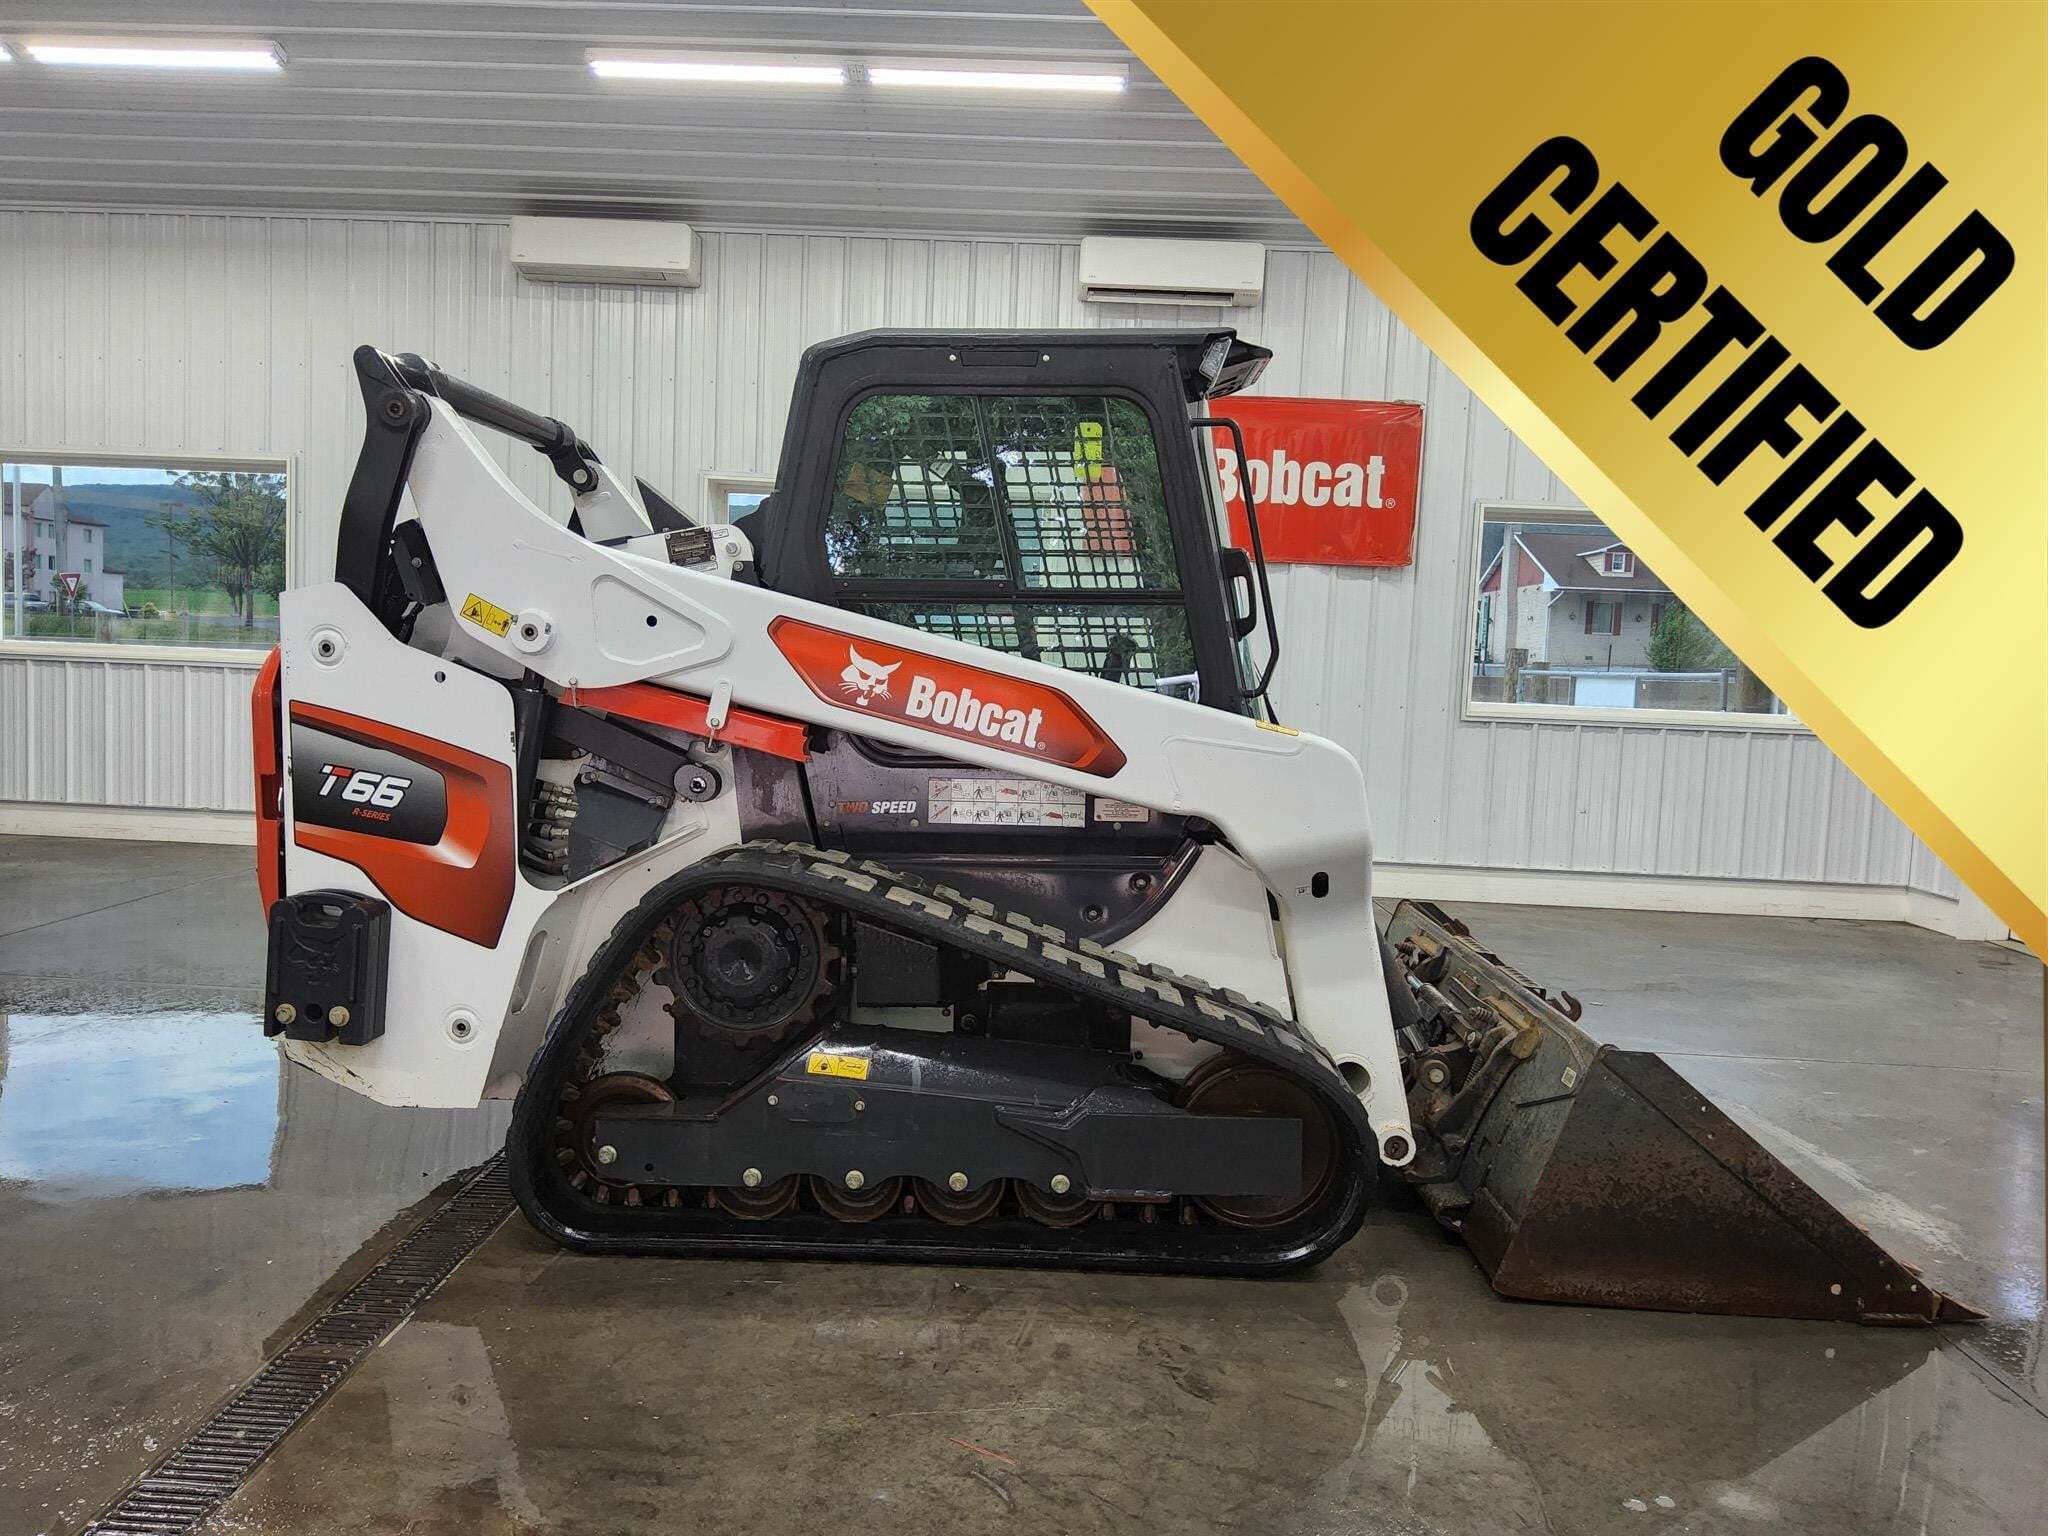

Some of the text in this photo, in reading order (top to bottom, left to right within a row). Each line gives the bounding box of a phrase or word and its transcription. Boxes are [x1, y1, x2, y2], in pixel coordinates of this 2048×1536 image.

[1215, 447, 1385, 509] Bobcat
[905, 675, 1043, 749] Bobcat
[319, 764, 413, 809] T66
[871, 800, 917, 814] SPEED
[351, 807, 391, 822] R-SERIES
